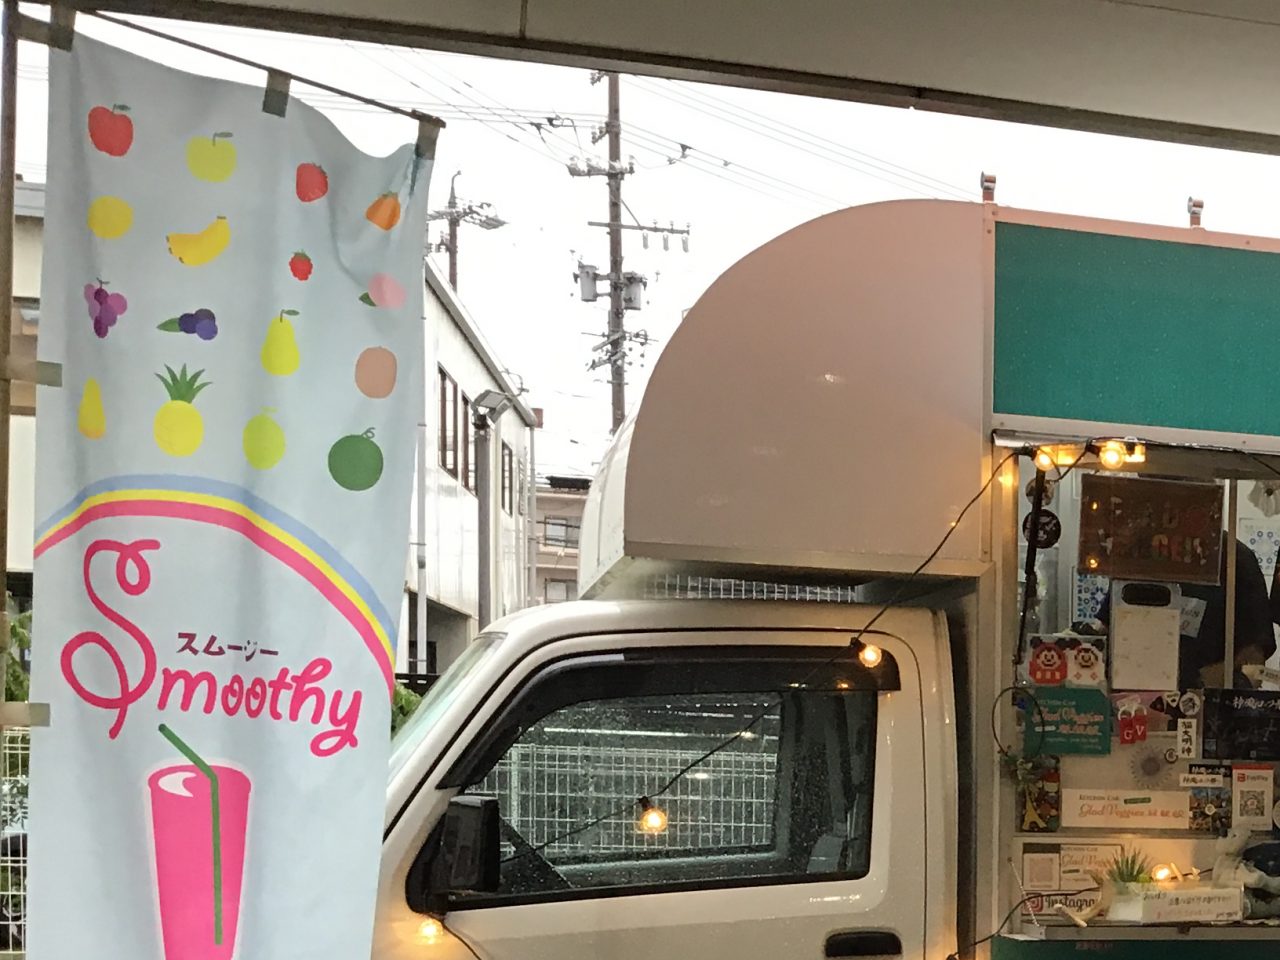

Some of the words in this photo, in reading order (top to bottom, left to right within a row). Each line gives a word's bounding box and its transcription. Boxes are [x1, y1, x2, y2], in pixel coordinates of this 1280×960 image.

[60, 539, 362, 757] Smoothy
[176, 632, 279, 661] スムージー
[1135, 725, 1145, 736] V
[1045, 895, 1095, 913] Instagra
